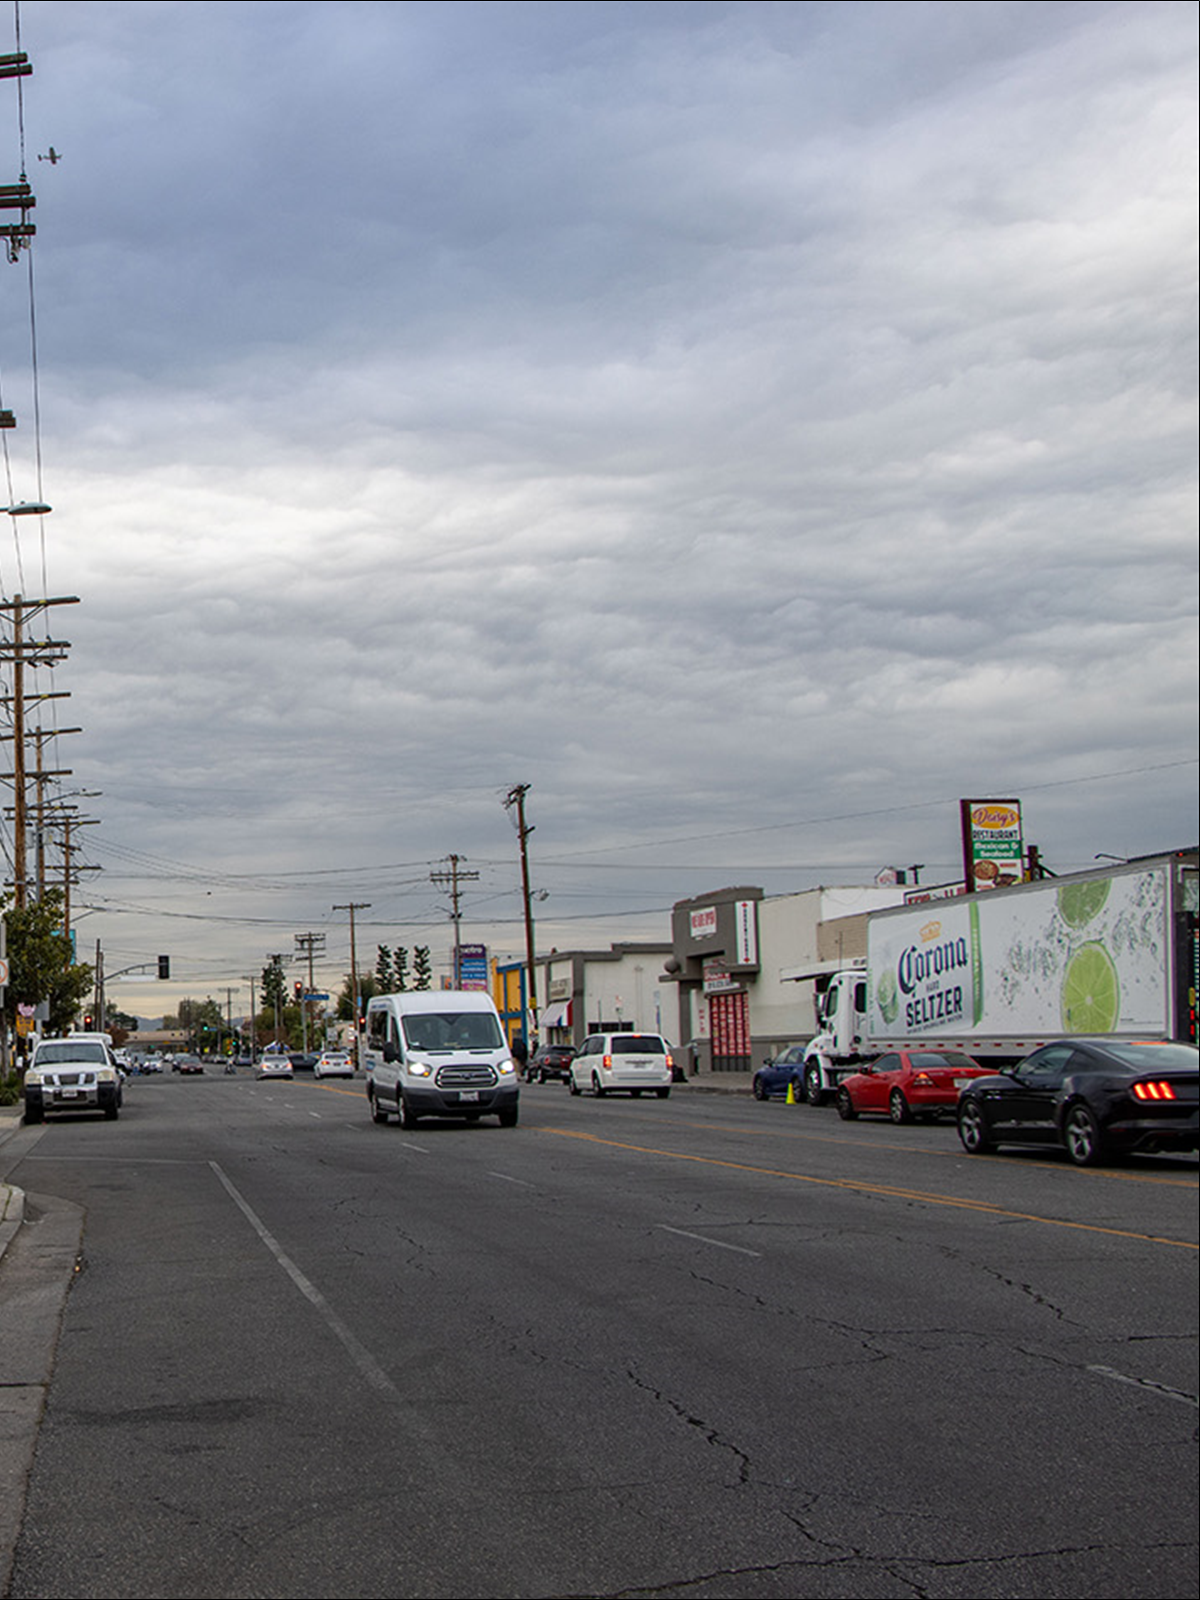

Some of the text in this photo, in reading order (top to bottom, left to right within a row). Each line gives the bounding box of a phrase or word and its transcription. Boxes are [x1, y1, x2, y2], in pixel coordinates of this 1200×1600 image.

[972, 807, 1015, 826] Daisy's
[972, 829, 1018, 839] RESTAURANT
[975, 842, 1010, 850] Mexican
[898, 936, 967, 997] Corona
[906, 985, 963, 1028] SELTZER
